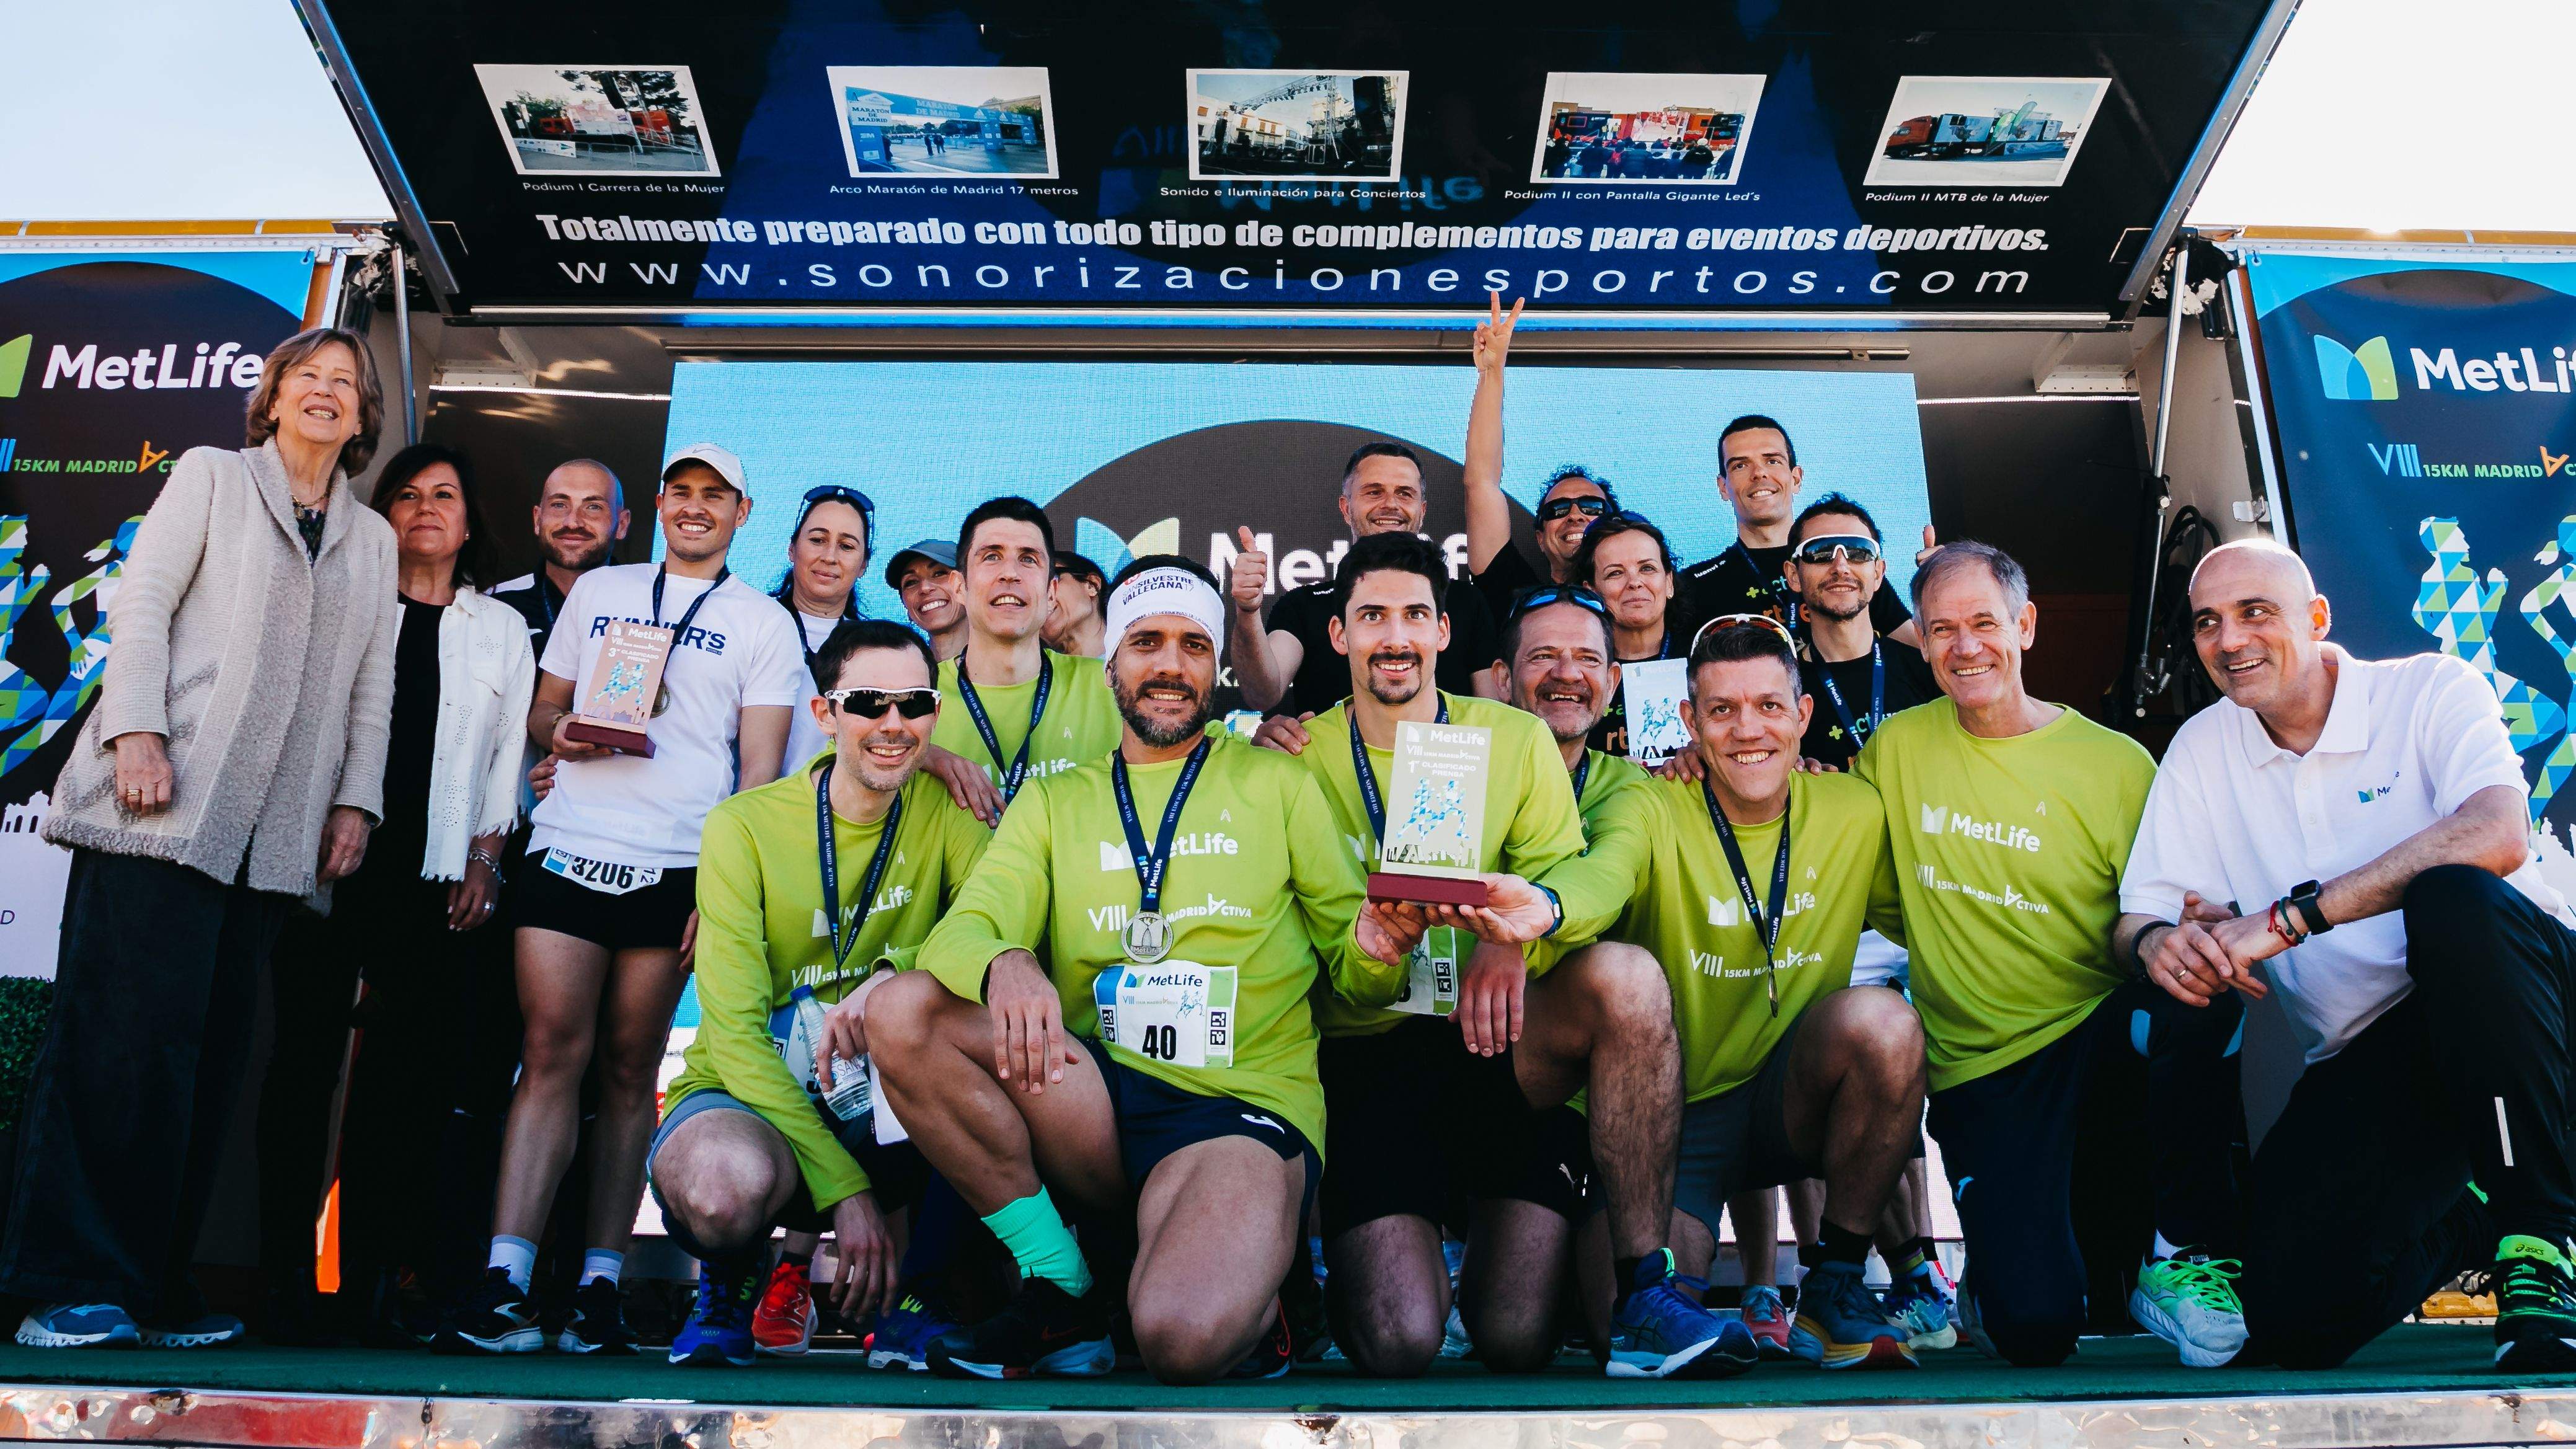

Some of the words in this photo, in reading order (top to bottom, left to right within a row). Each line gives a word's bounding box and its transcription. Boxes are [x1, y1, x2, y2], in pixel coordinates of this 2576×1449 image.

[685, 185, 724, 193] Mujer
[868, 185, 924, 193] Maratón
[1228, 188, 1308, 197] Iluminación
[1351, 190, 1425, 198] Conciertos
[1666, 192, 1720, 202] Gigante
[1866, 193, 1915, 201] Podium
[2009, 194, 2049, 202] Mujer
[536, 215, 756, 242] Totalmente
[764, 218, 965, 245] preparado
[975, 223, 1047, 244] con
[1053, 219, 1141, 245] todo
[1150, 220, 1226, 247] tipo
[1236, 221, 1283, 246] de
[1293, 222, 1583, 249] complementos
[1590, 228, 1679, 251] para
[1686, 226, 1838, 250] eventos
[1843, 225, 2048, 252] deportivos.
[559, 258, 2029, 298] www.sonorizacionesportos.com
[42, 342, 263, 389] MetLife
[14, 459, 60, 472] 15KM
[65, 459, 138, 473] MADRID
[2367, 443, 2422, 477] VIII
[2423, 464, 2469, 478] 15KM
[2474, 464, 2543, 478] MADRID
[1122, 581, 1183, 606] VALLECANA
[628, 627, 667, 642] MetLife
[1830, 686, 1843, 706] MetLife
[1430, 730, 1486, 745] MetLife
[1406, 745, 1423, 756] VIII
[1012, 762, 1024, 786] MetLife
[1422, 761, 1476, 772] CLASIFICADO
[1432, 769, 1465, 778] PRENSA
[1950, 812, 2041, 853] MetLife
[825, 841, 833, 866] MADRID
[571, 856, 635, 889] 3206
[1149, 859, 1163, 887] MetLife
[1740, 876, 1755, 903] MetLife
[1962, 884, 2004, 905] MADRID
[1087, 904, 1127, 933] VIII
[1771, 916, 1779, 944] MetLife
[1133, 946, 1160, 955] MetLife
[1689, 949, 1724, 977] VIII
[1724, 968, 1750, 978] 15KM
[1148, 974, 1203, 987] MetLife
[1122, 995, 1135, 1005] VIII
[1141, 1025, 1177, 1061] 40
[2525, 1246, 2544, 1256] asics
